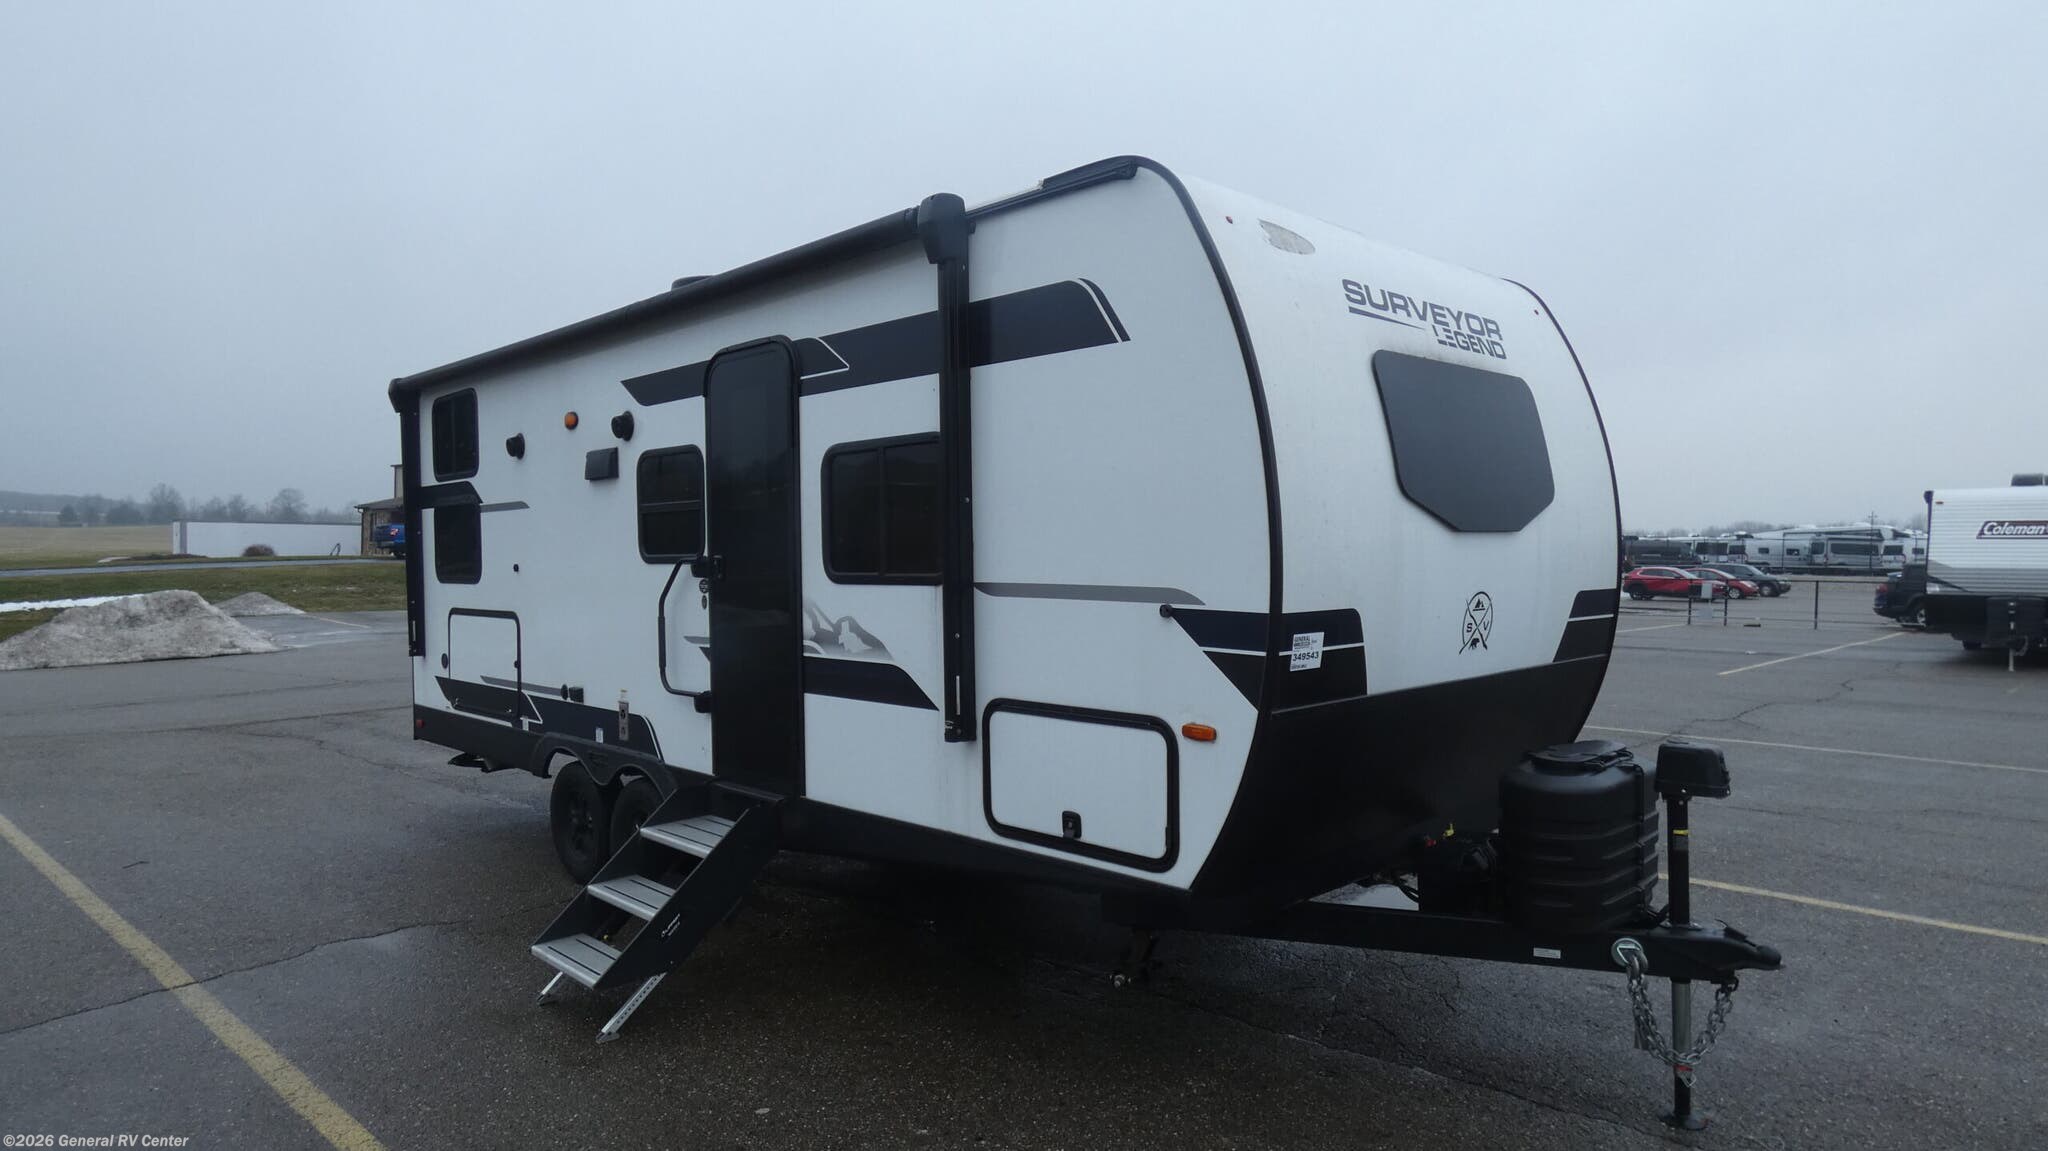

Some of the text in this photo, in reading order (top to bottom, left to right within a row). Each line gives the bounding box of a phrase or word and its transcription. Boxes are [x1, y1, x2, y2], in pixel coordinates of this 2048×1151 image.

[1341, 279, 1504, 341] SURVEYOR
[1432, 324, 1508, 360] LEGEND
[1983, 522, 2046, 535] Coleman
[1292, 651, 1319, 662] 349543
